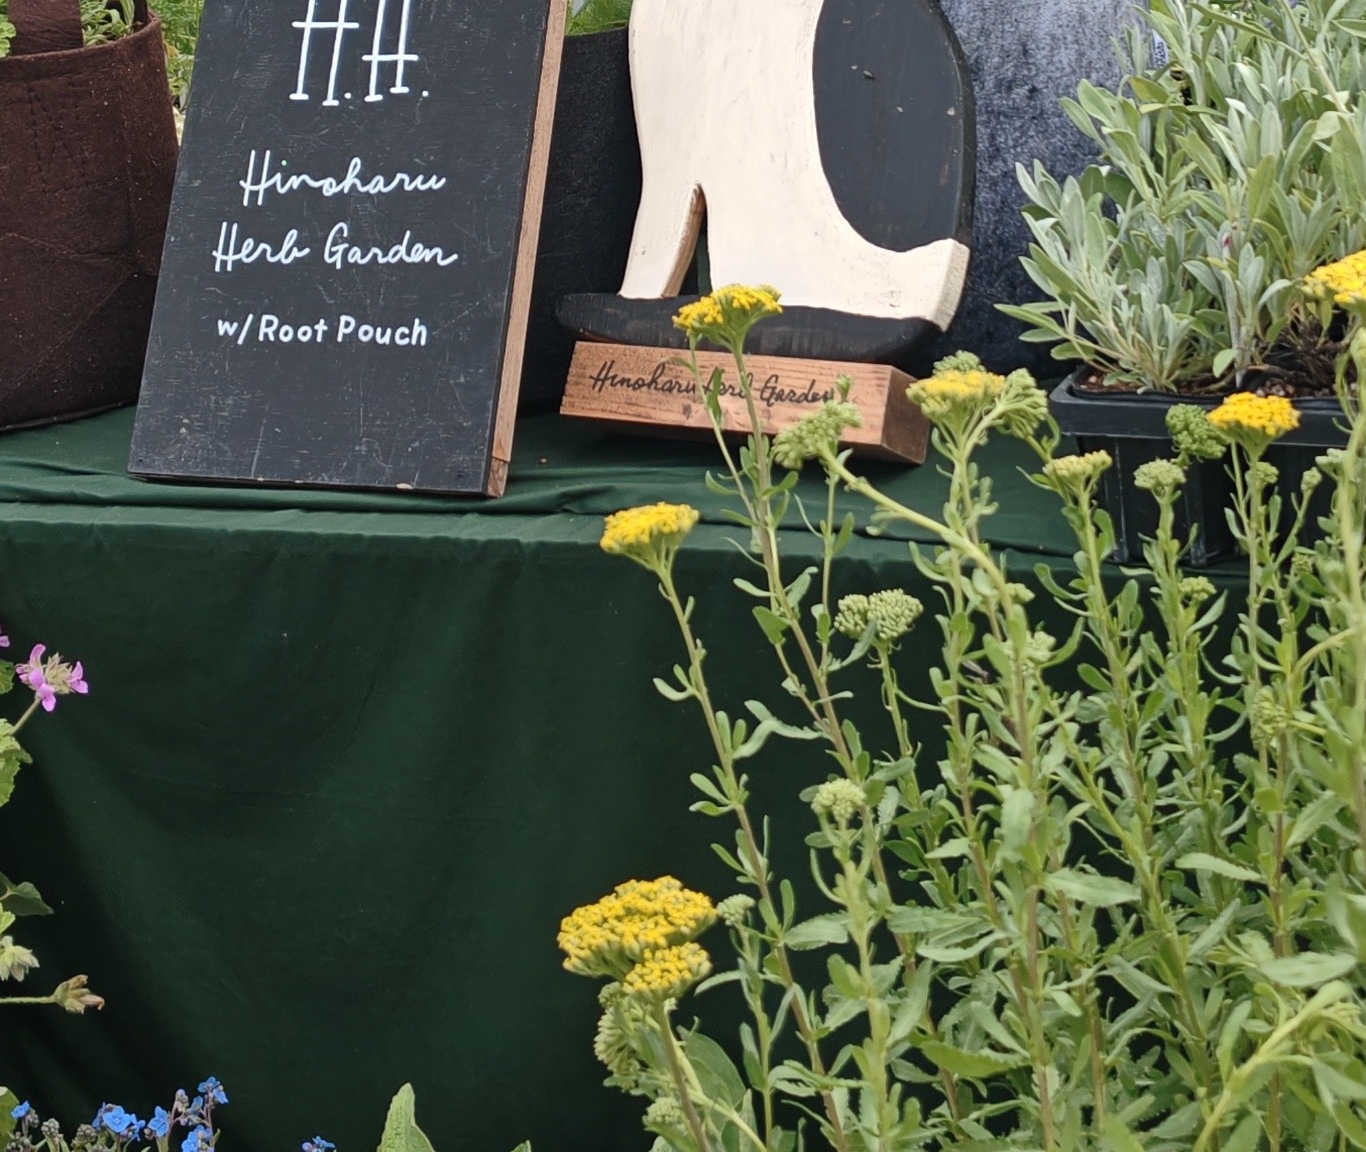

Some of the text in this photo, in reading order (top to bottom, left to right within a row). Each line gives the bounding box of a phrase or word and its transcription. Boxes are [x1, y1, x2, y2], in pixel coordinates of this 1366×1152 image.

[239, 149, 446, 207] Hinoharu
[212, 221, 458, 272] Herb Garden
[337, 315, 427, 346] Pouch
